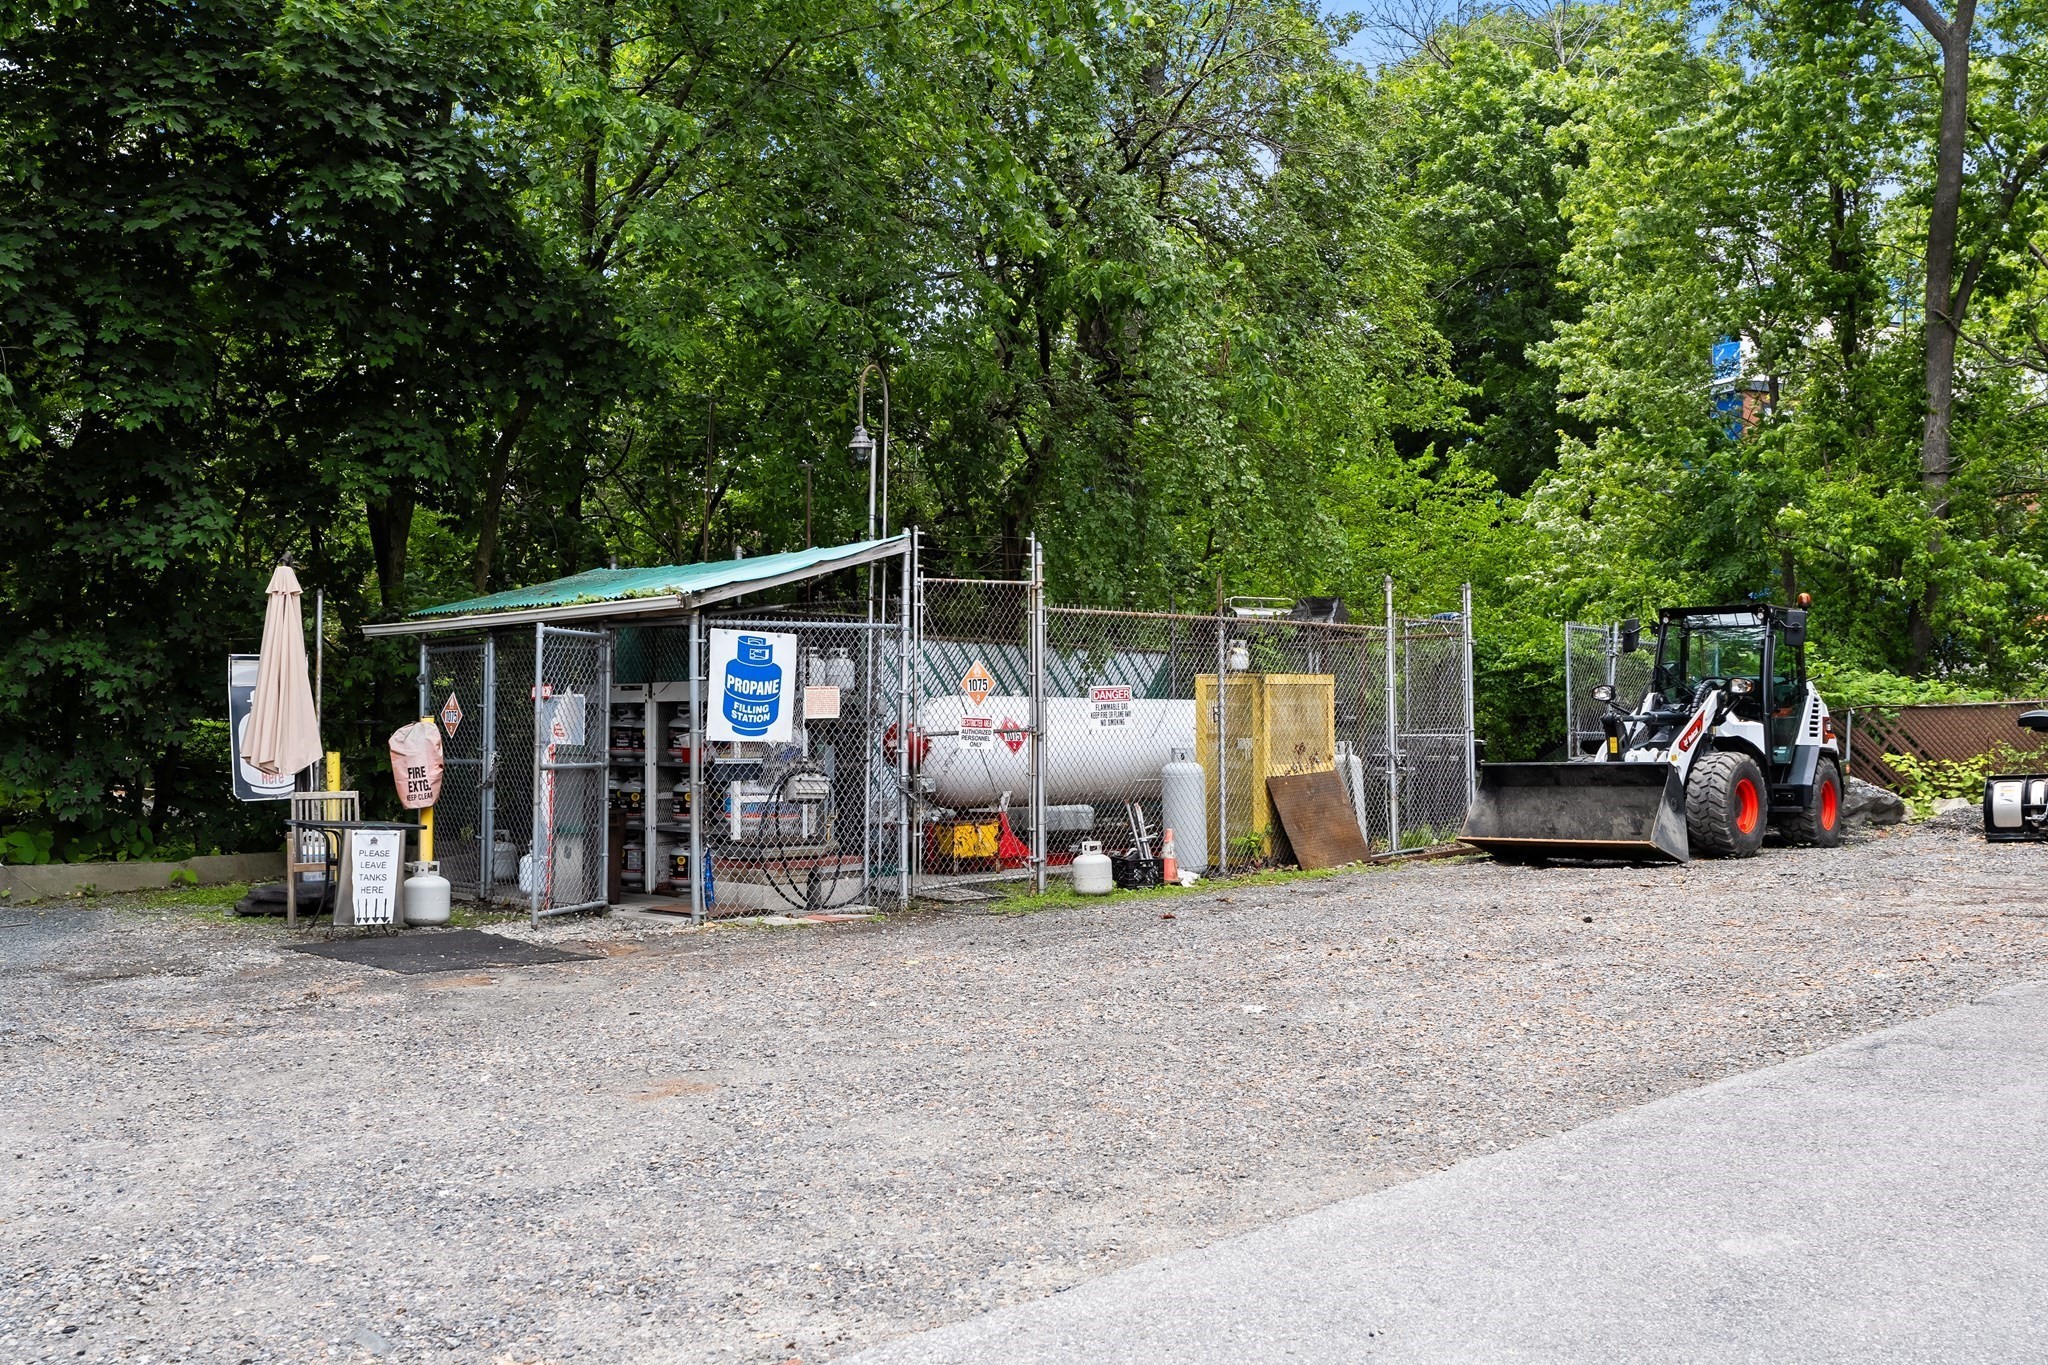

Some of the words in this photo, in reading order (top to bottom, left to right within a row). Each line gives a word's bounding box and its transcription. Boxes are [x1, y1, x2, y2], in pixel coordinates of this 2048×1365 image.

[727, 674, 780, 695] PROPANE
[968, 679, 988, 691] 1075
[1094, 690, 1130, 700] DANGER
[733, 701, 769, 713] FILLING
[731, 709, 770, 723] STATION
[1006, 732, 1021, 741] 1075
[407, 766, 426, 779] FIRE
[261, 772, 284, 785] Here
[408, 779, 431, 793] EXTG.
[406, 794, 417, 802] KEEP
[417, 792, 434, 801] CLEAR
[358, 849, 391, 858] PLEASE
[360, 861, 387, 869] LEAVE
[359, 873, 388, 882] TANKS
[360, 885, 384, 895] HERE
